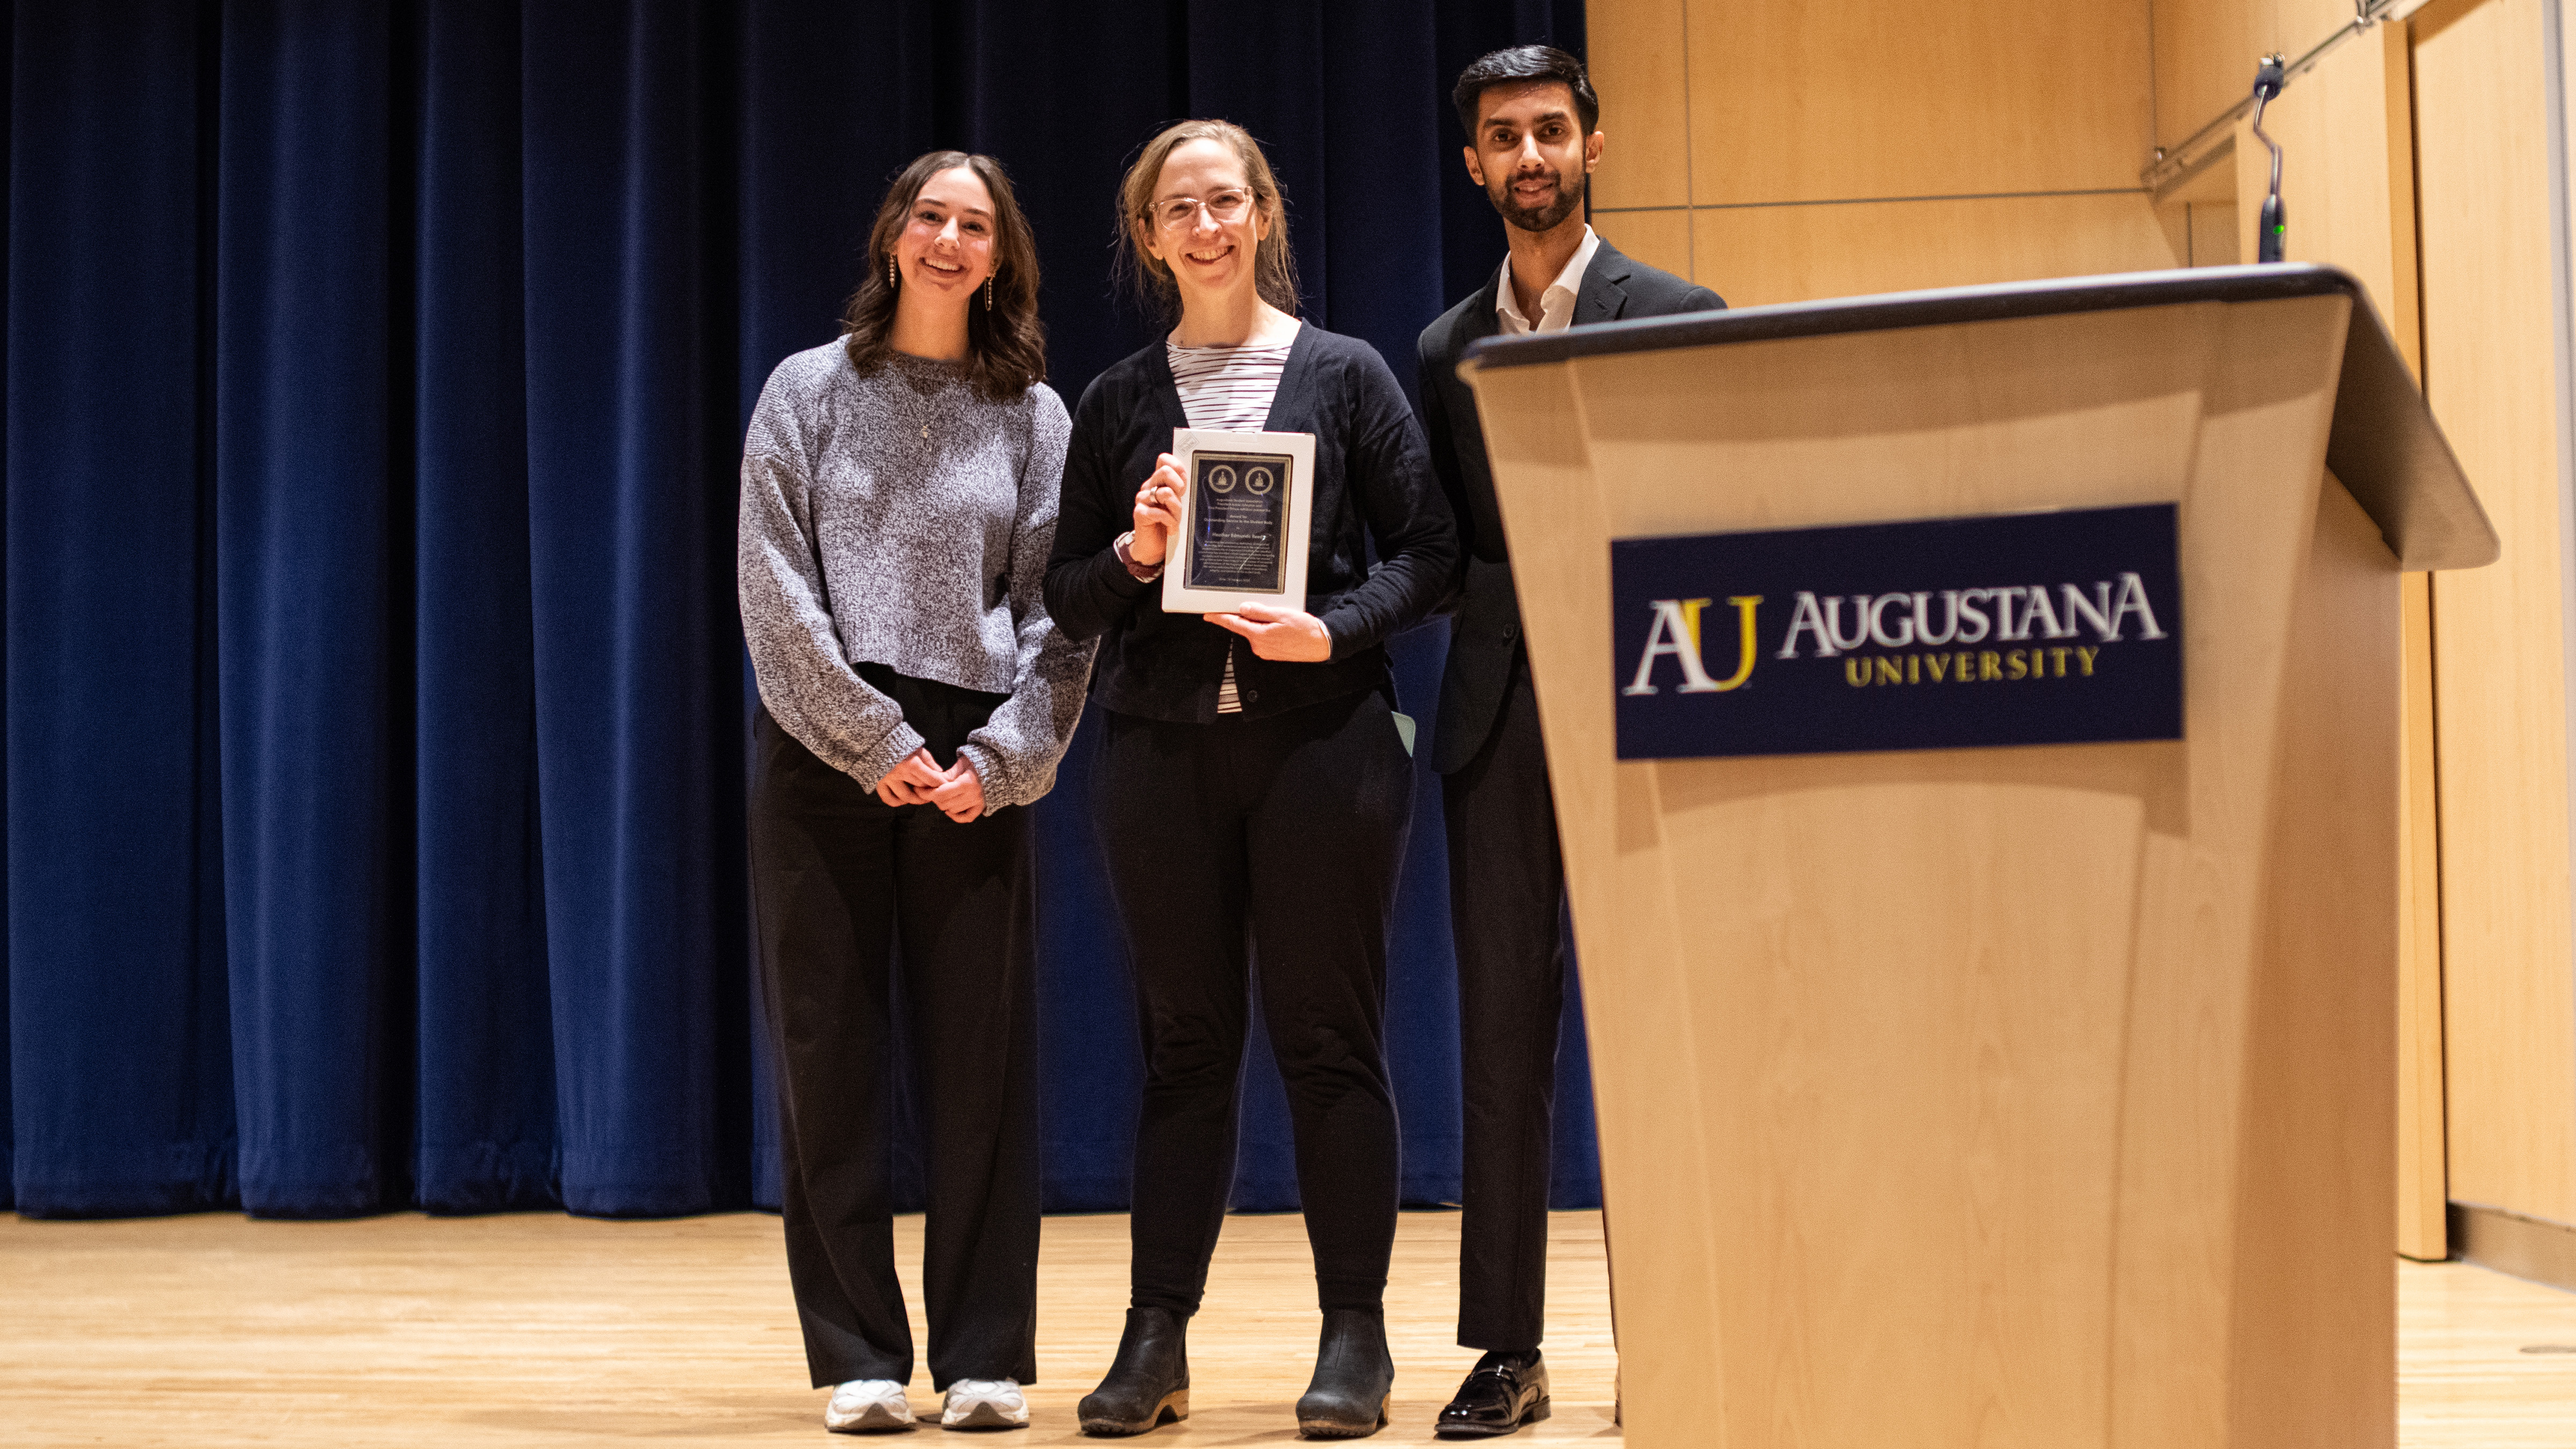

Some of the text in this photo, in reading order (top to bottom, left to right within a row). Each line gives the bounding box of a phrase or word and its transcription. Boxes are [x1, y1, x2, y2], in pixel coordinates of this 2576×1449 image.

[1622, 595, 1763, 696] AU
[1775, 573, 2168, 660] AUGUSTANA
[1845, 646, 2101, 687] UNIVERSITY
